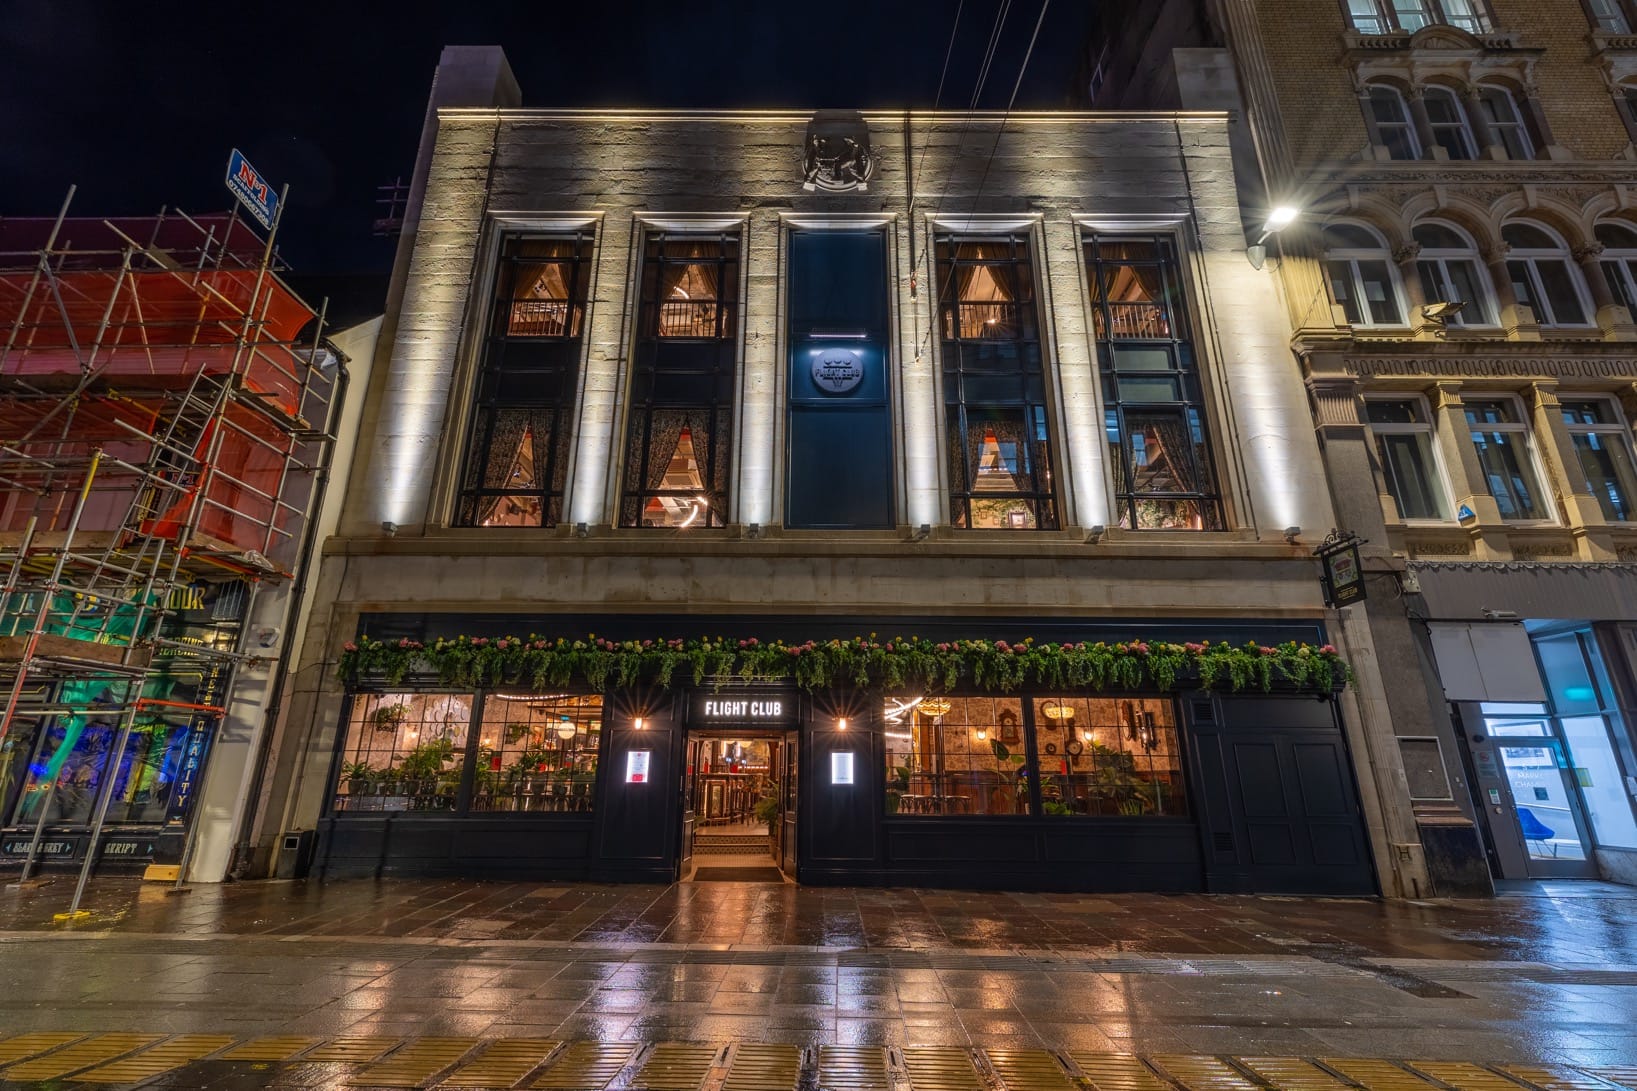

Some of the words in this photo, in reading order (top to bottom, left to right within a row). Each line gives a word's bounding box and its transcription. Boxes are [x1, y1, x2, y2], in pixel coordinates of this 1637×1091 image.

[232, 173, 270, 216] SCAFFOLDING
[705, 701, 749, 716] FLIGHT
[751, 701, 782, 716] CLUB
[177, 720, 205, 807] QUALITY
